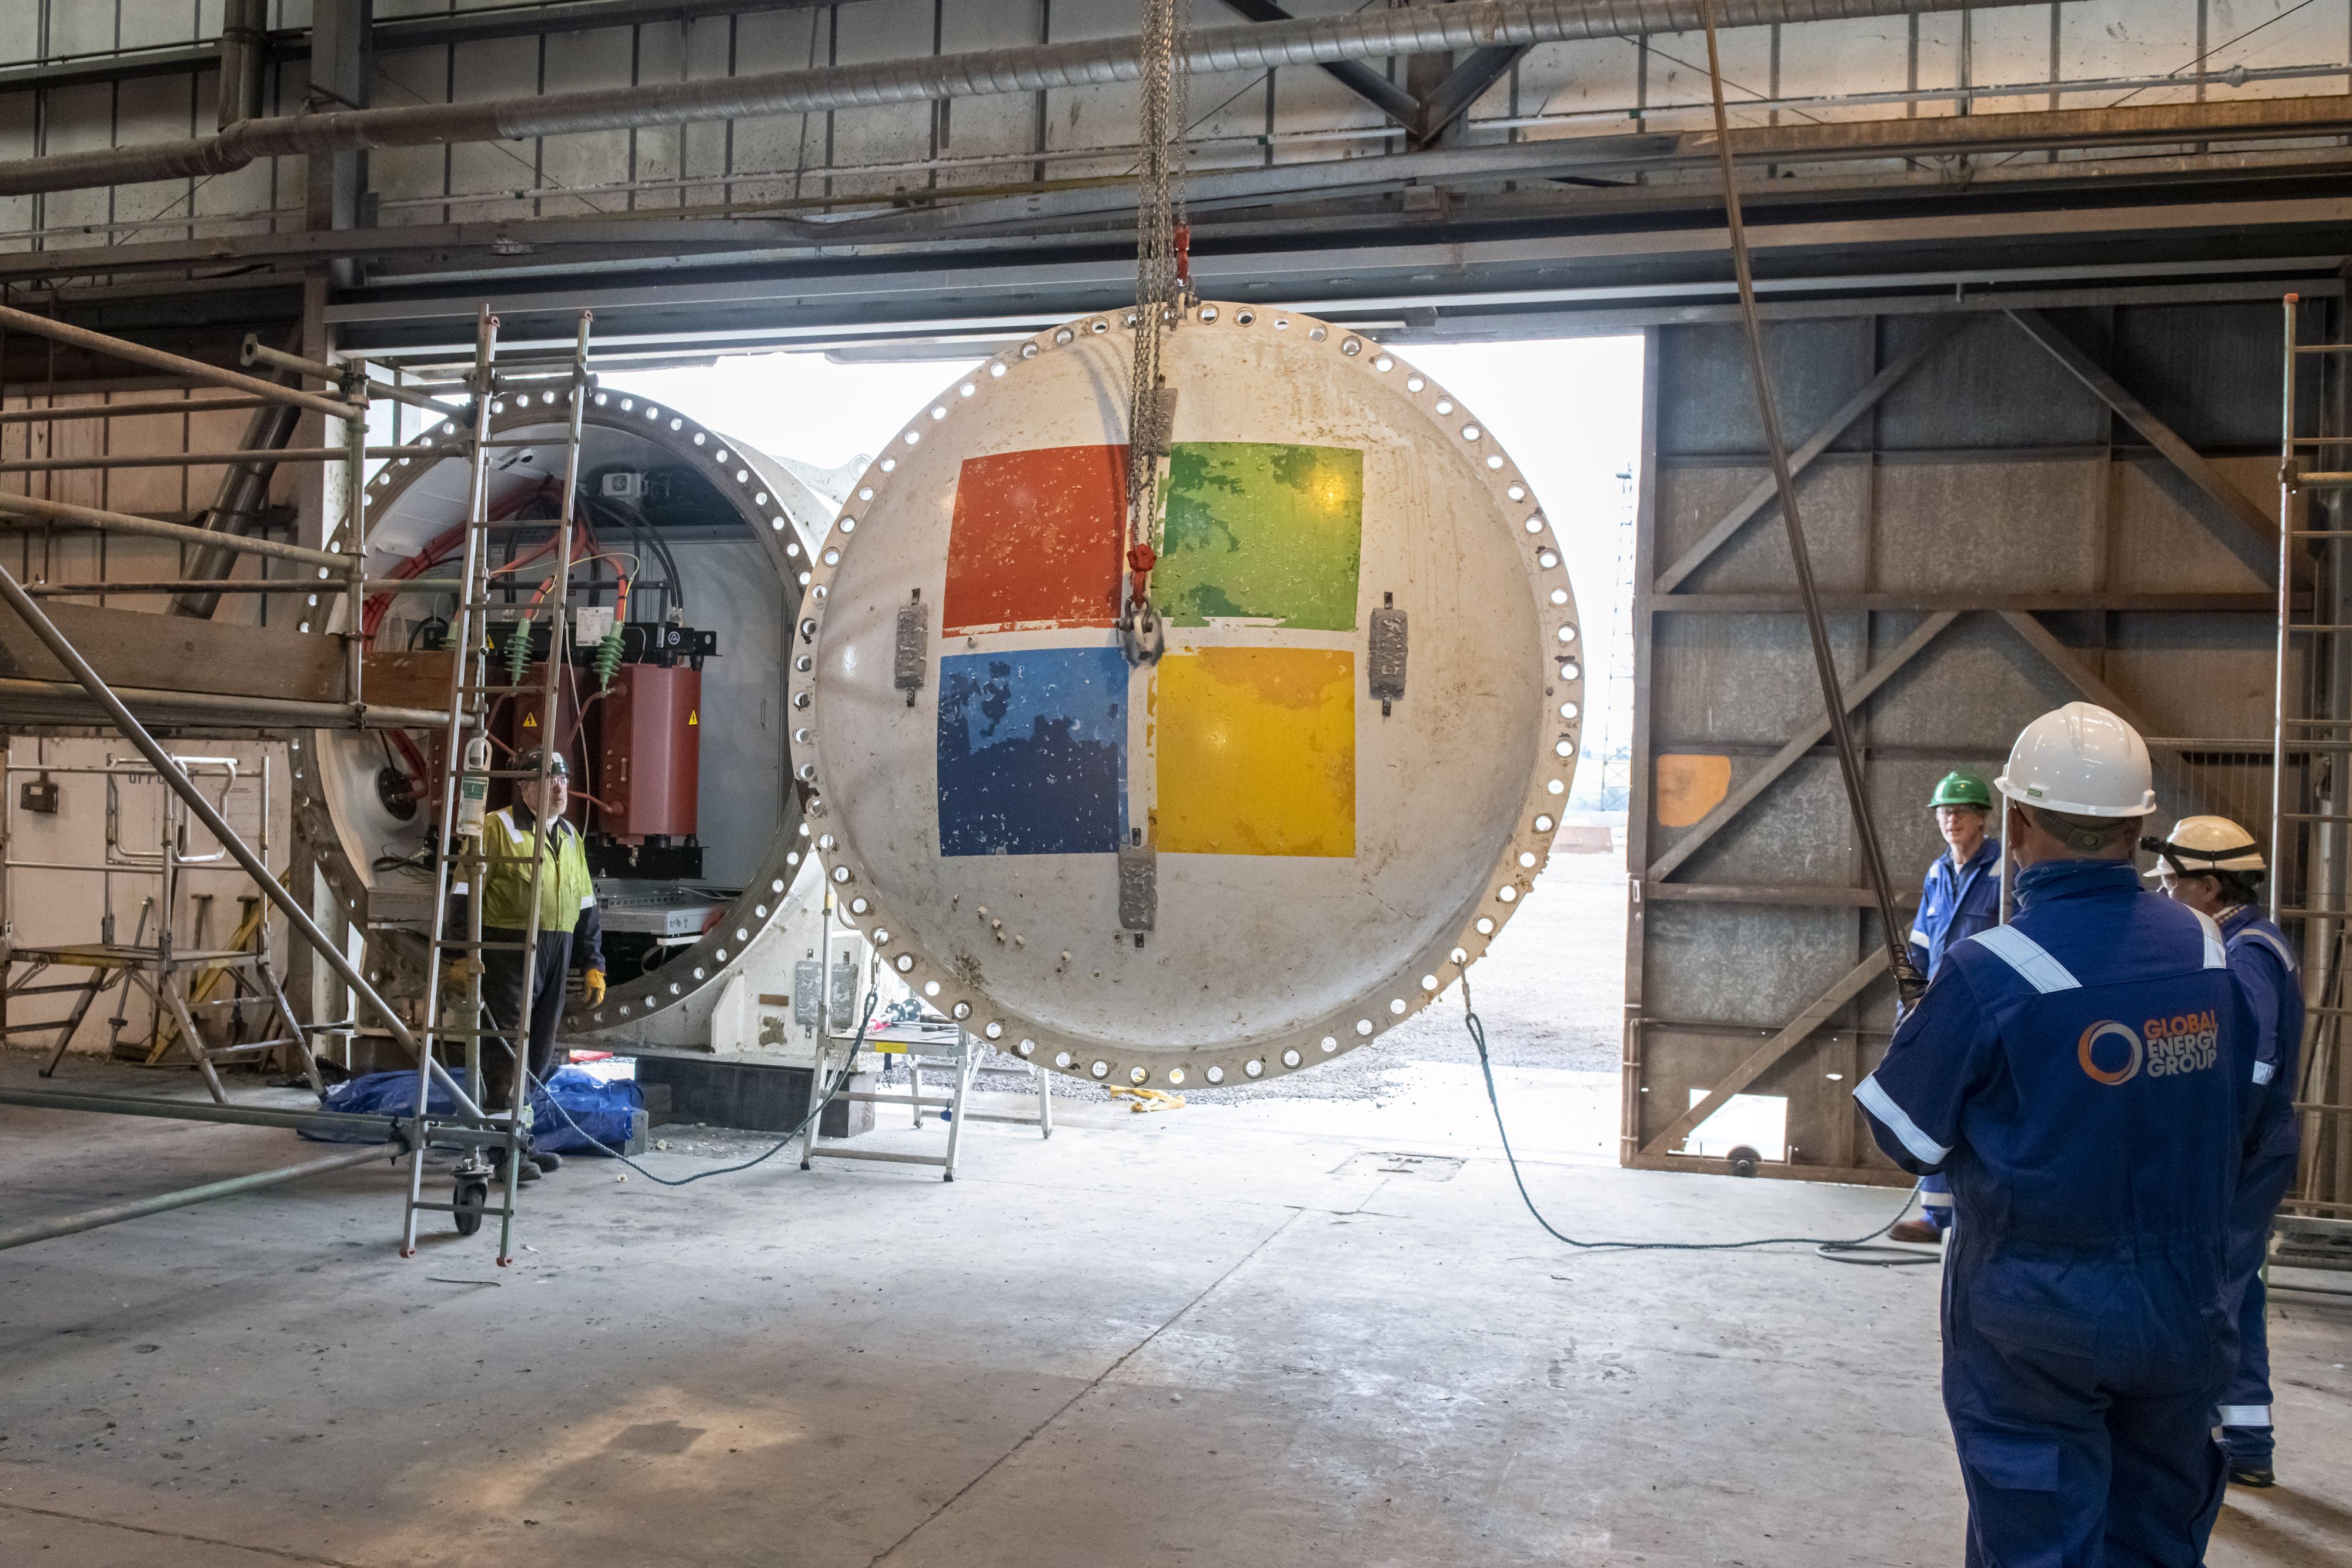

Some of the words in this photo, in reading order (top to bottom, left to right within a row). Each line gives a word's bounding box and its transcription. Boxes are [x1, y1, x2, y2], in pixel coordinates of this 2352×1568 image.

[2144, 1009, 2219, 1039] GLOBAL
[2147, 1028, 2218, 1058] ENERGY
[2147, 1049, 2217, 1077] GROUP
